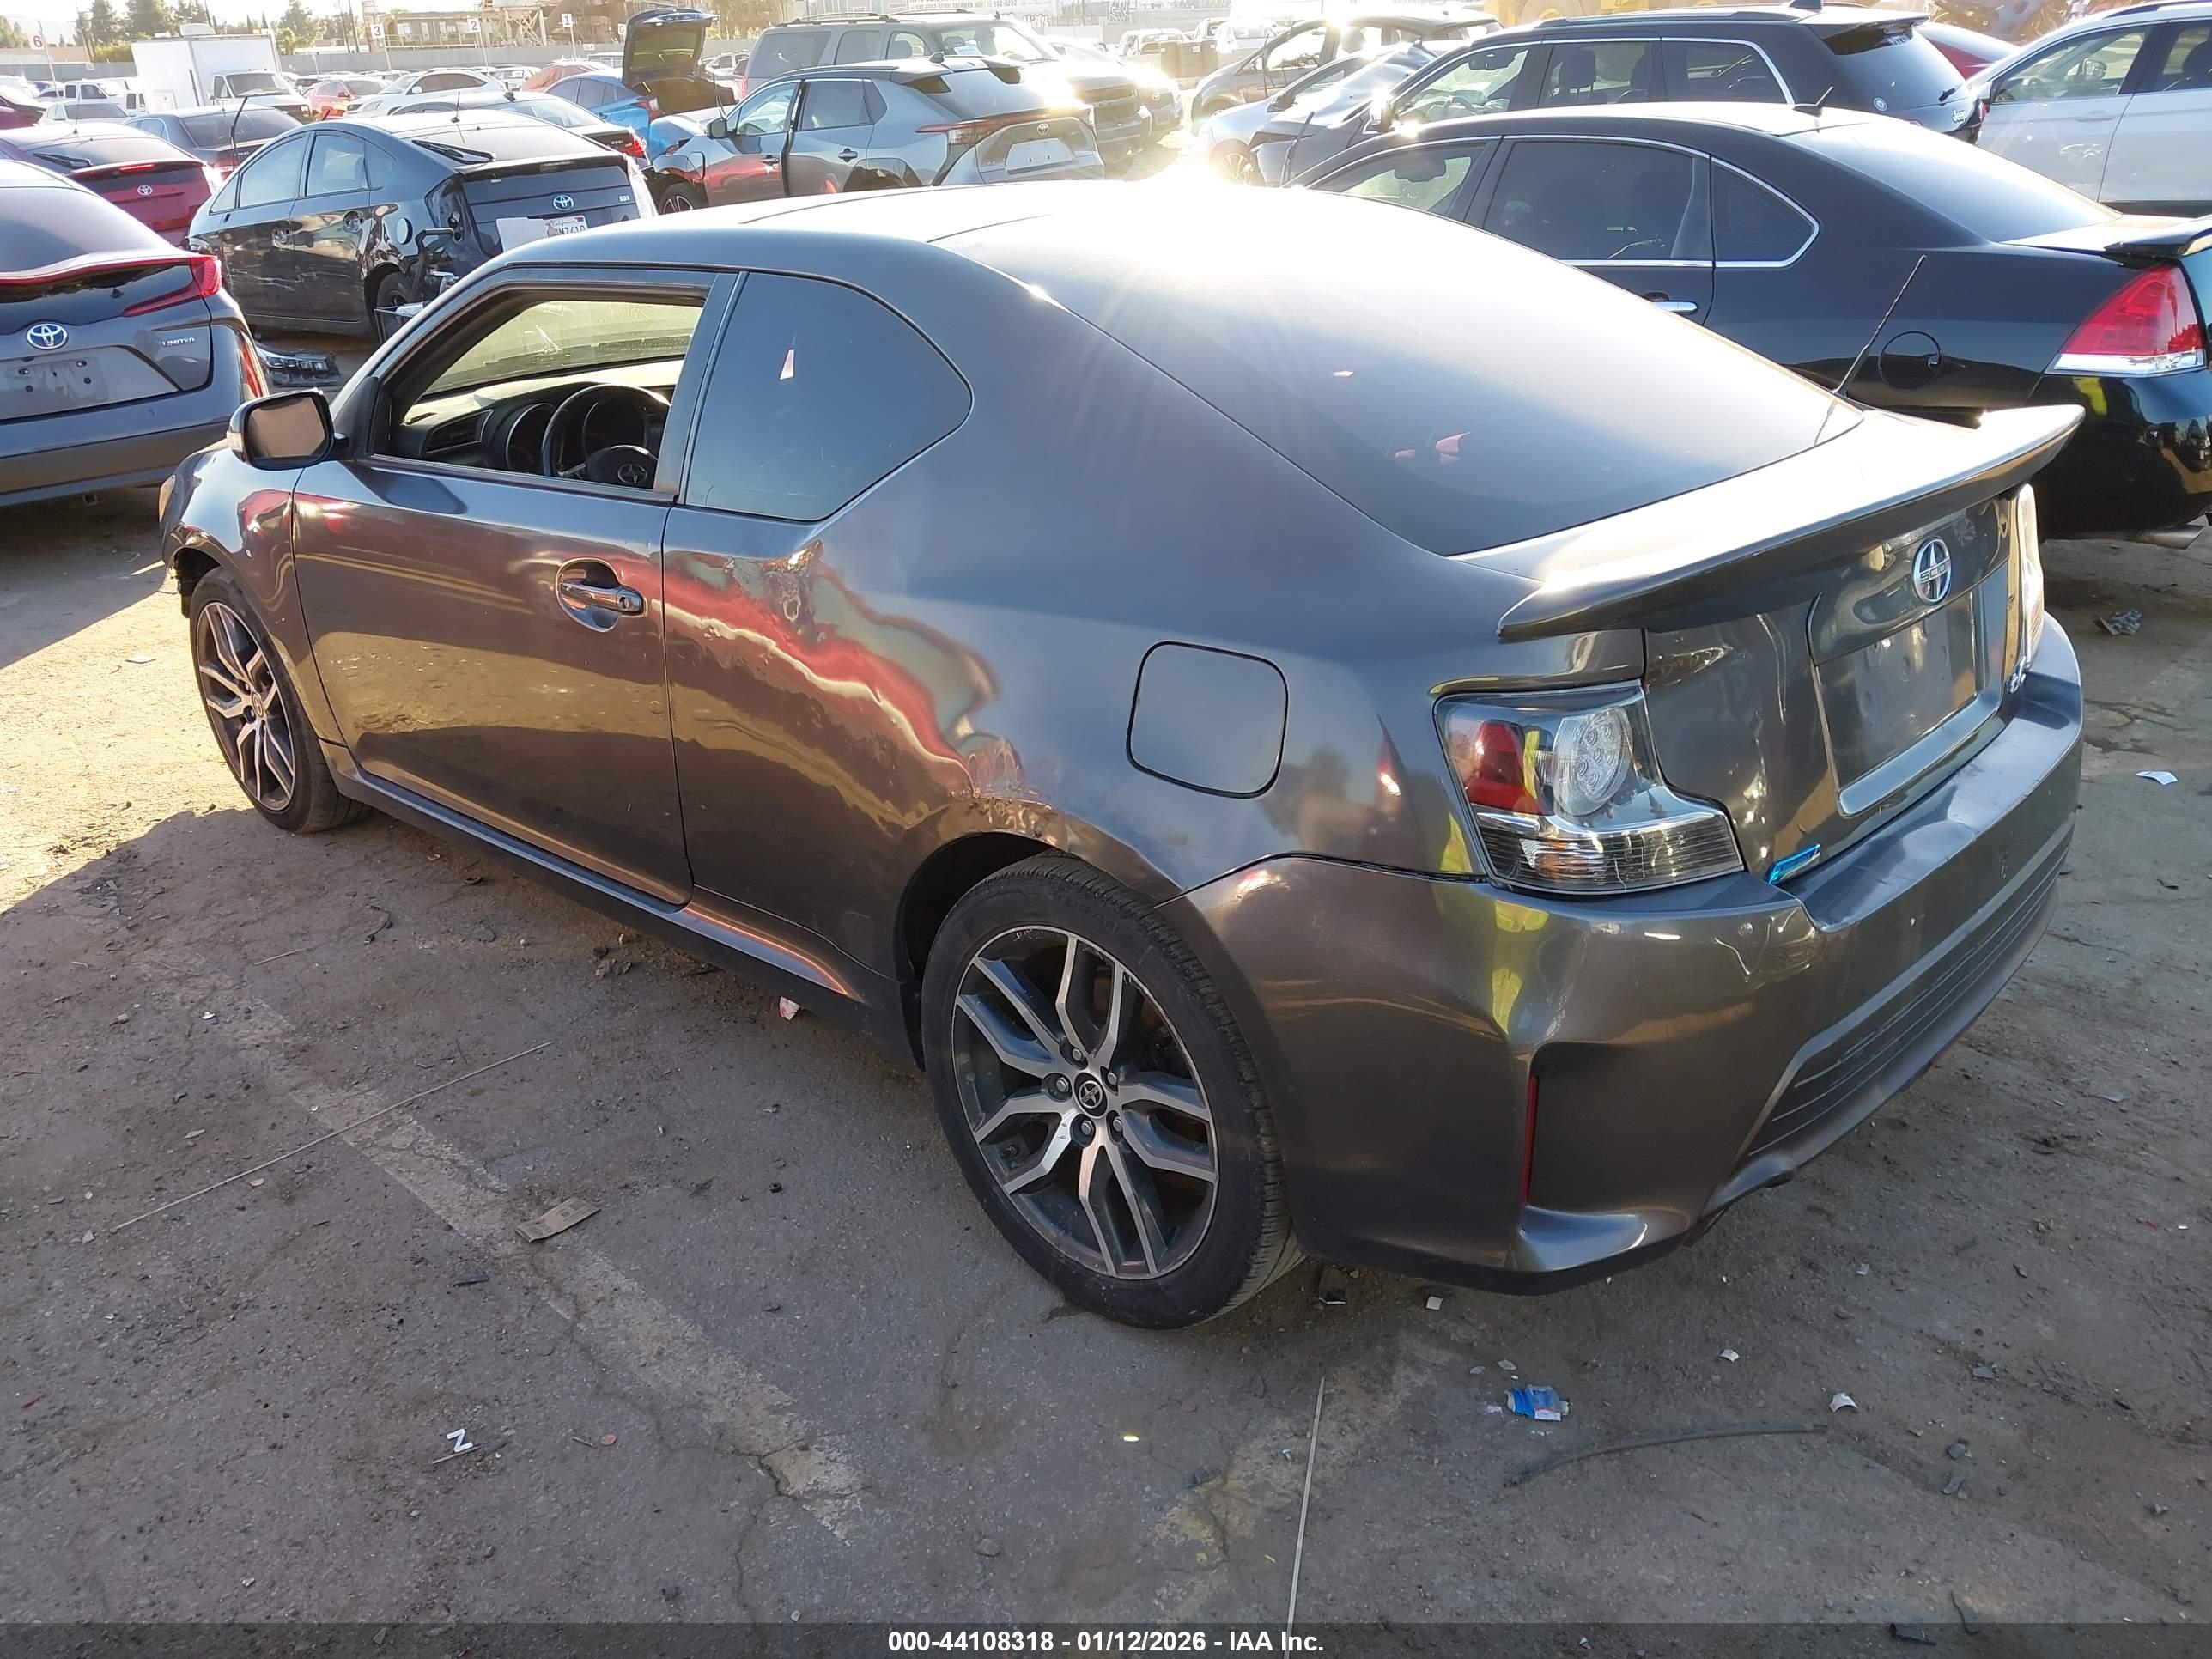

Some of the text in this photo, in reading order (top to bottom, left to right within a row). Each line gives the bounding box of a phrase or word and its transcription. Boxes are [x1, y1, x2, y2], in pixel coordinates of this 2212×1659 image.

[470, 20, 478, 31] 2
[563, 15, 570, 26] 1
[374, 26, 381, 36] 3
[33, 35, 42, 47] 6
[1952, 109, 1967, 123] Jeep
